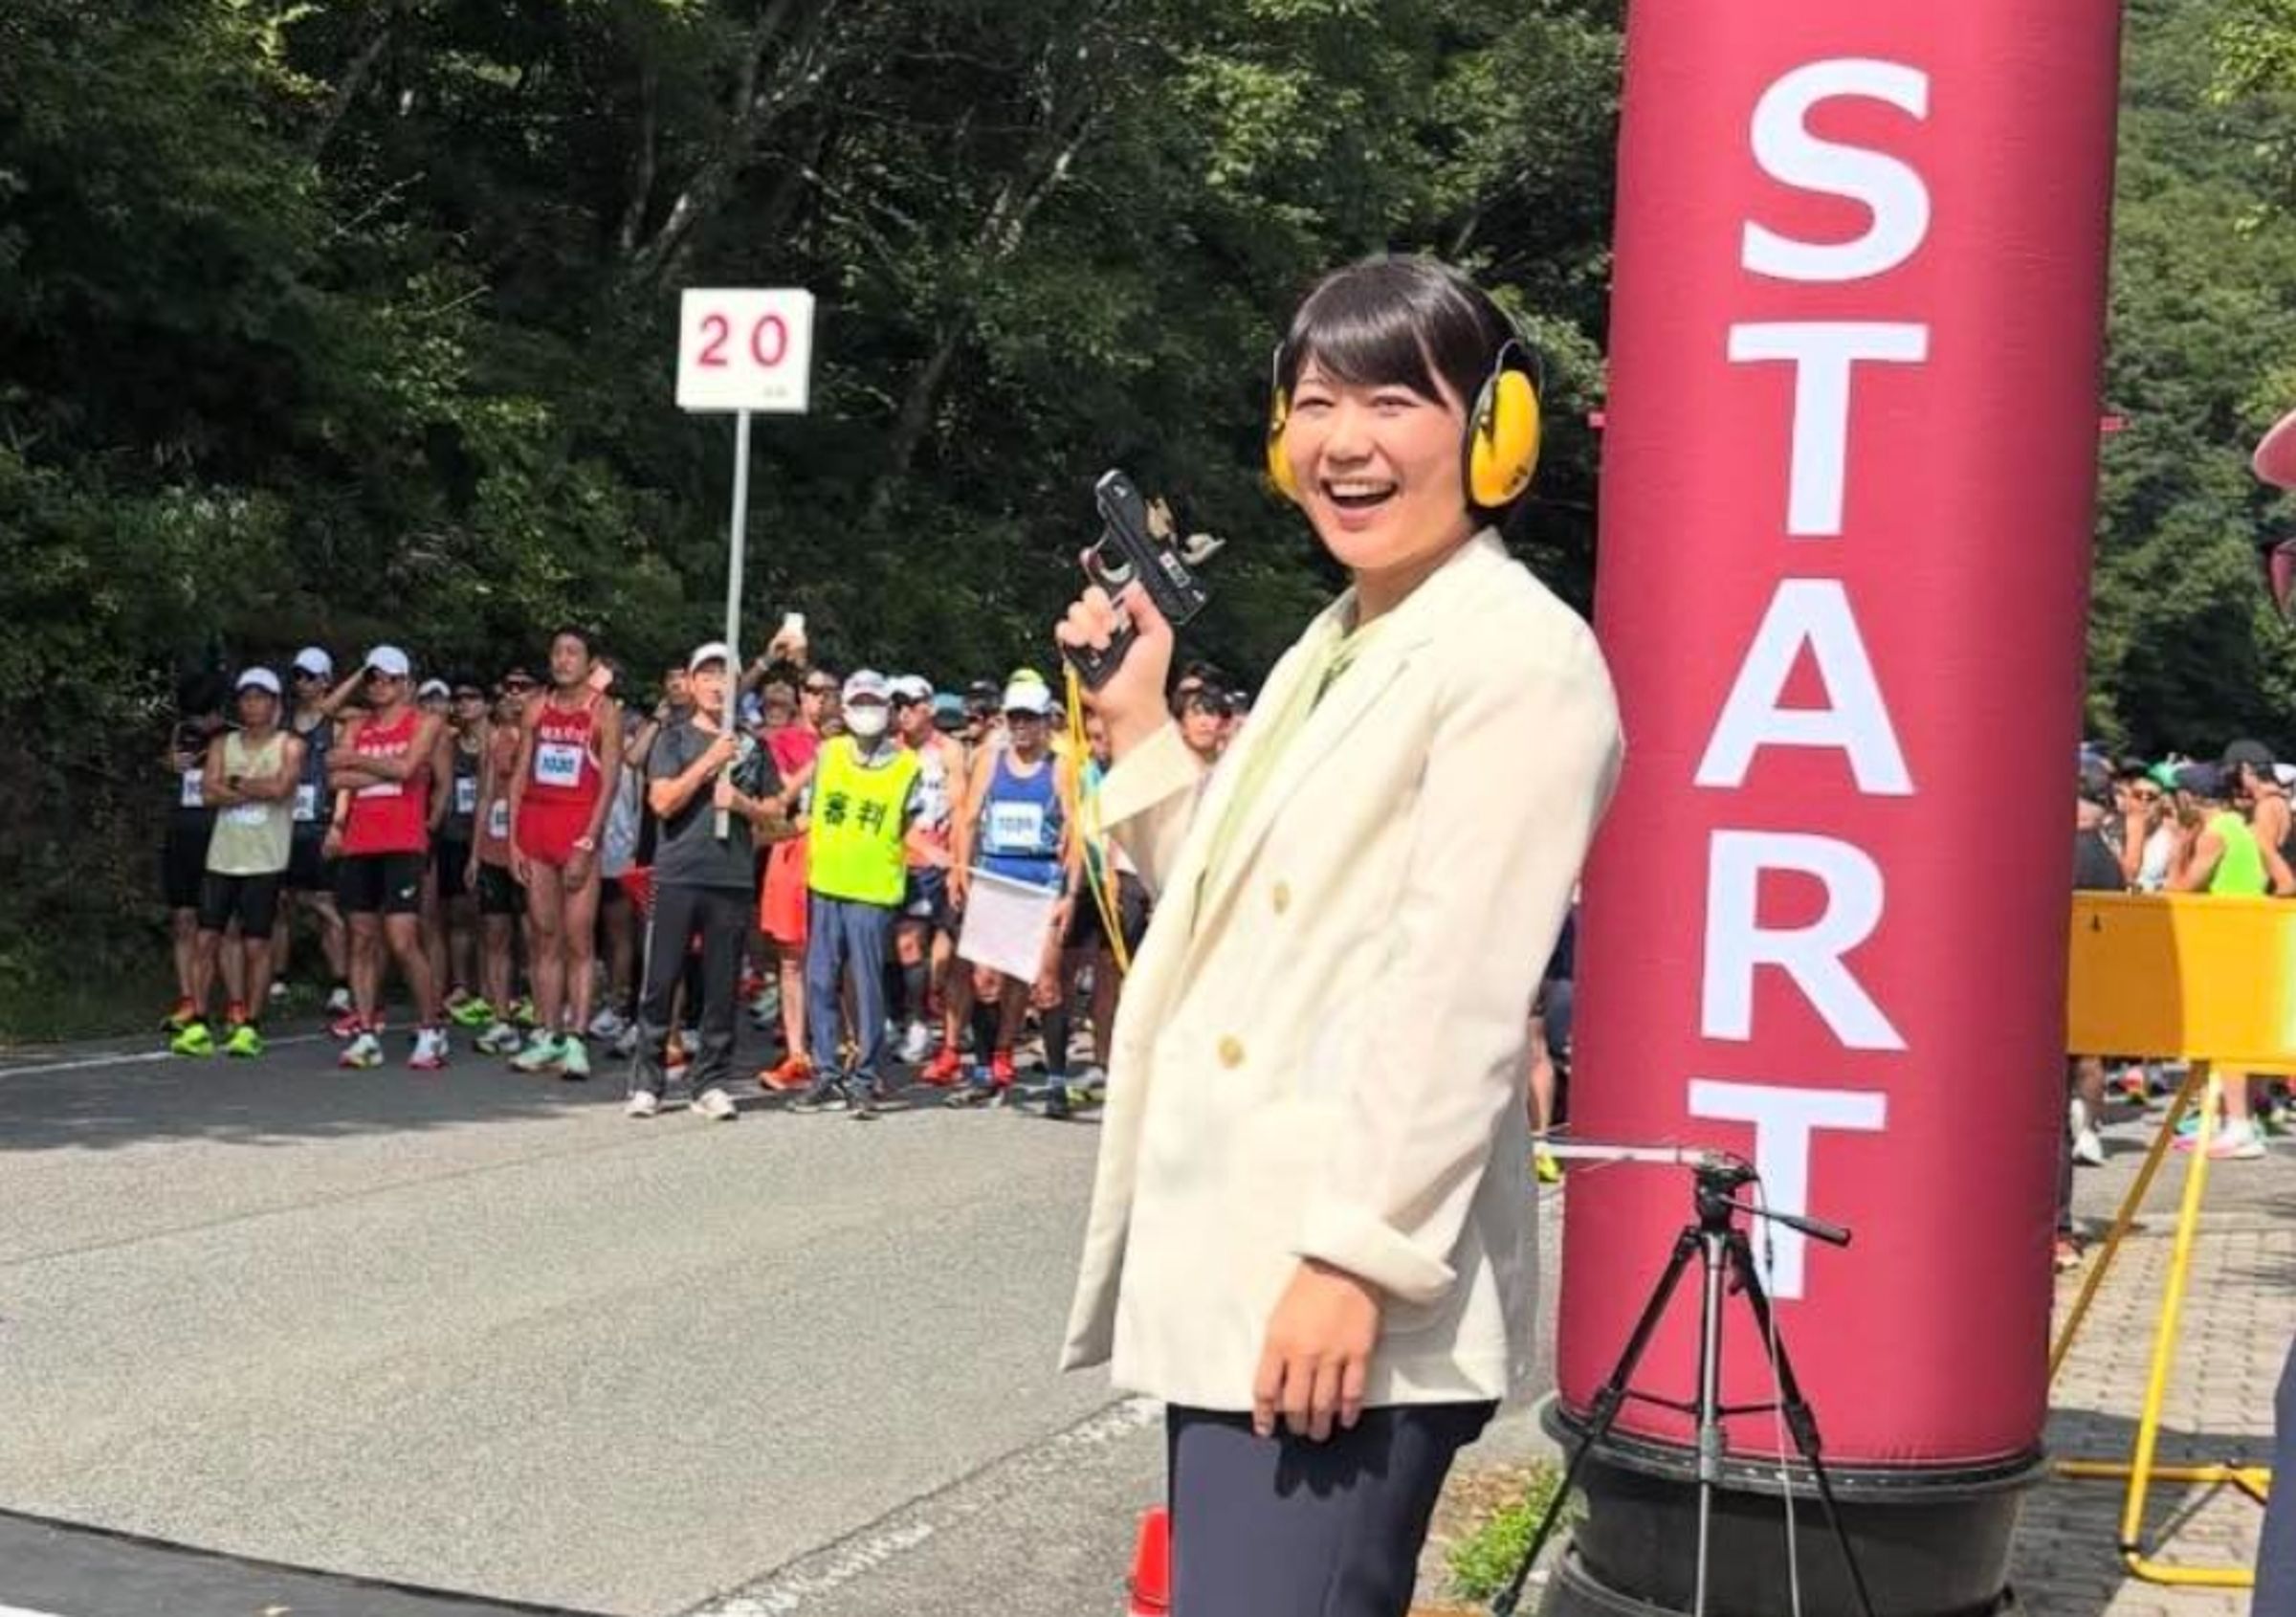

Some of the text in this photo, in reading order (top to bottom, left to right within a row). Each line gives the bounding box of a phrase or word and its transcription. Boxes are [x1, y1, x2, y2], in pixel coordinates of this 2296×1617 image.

[699, 314, 788, 367] 20
[1688, 57, 1931, 1300] START
[824, 789, 889, 836] 審判
